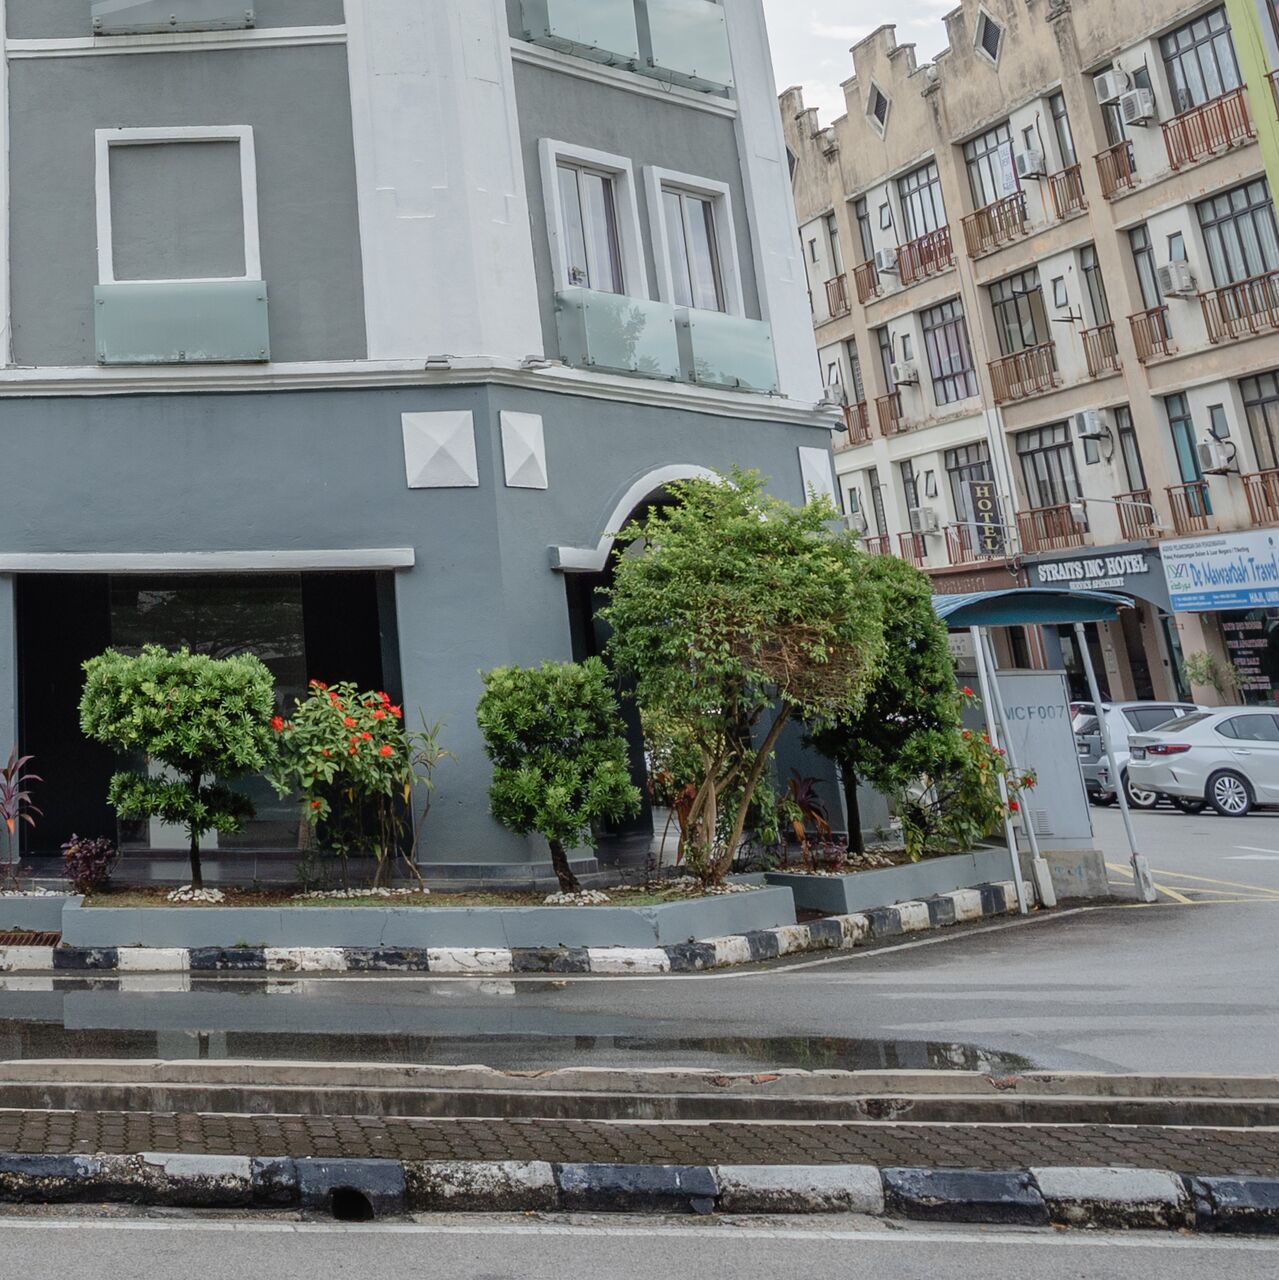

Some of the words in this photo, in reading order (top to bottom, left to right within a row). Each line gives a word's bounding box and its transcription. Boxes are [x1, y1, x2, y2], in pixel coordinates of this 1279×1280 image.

[975, 486, 999, 550] HOTEL
[1038, 561, 1084, 582] STRAITS
[1083, 559, 1105, 577] INC
[1105, 554, 1148, 575] HOTEL
[1248, 552, 1279, 581] Travel
[1004, 705, 1064, 720] MCF007
